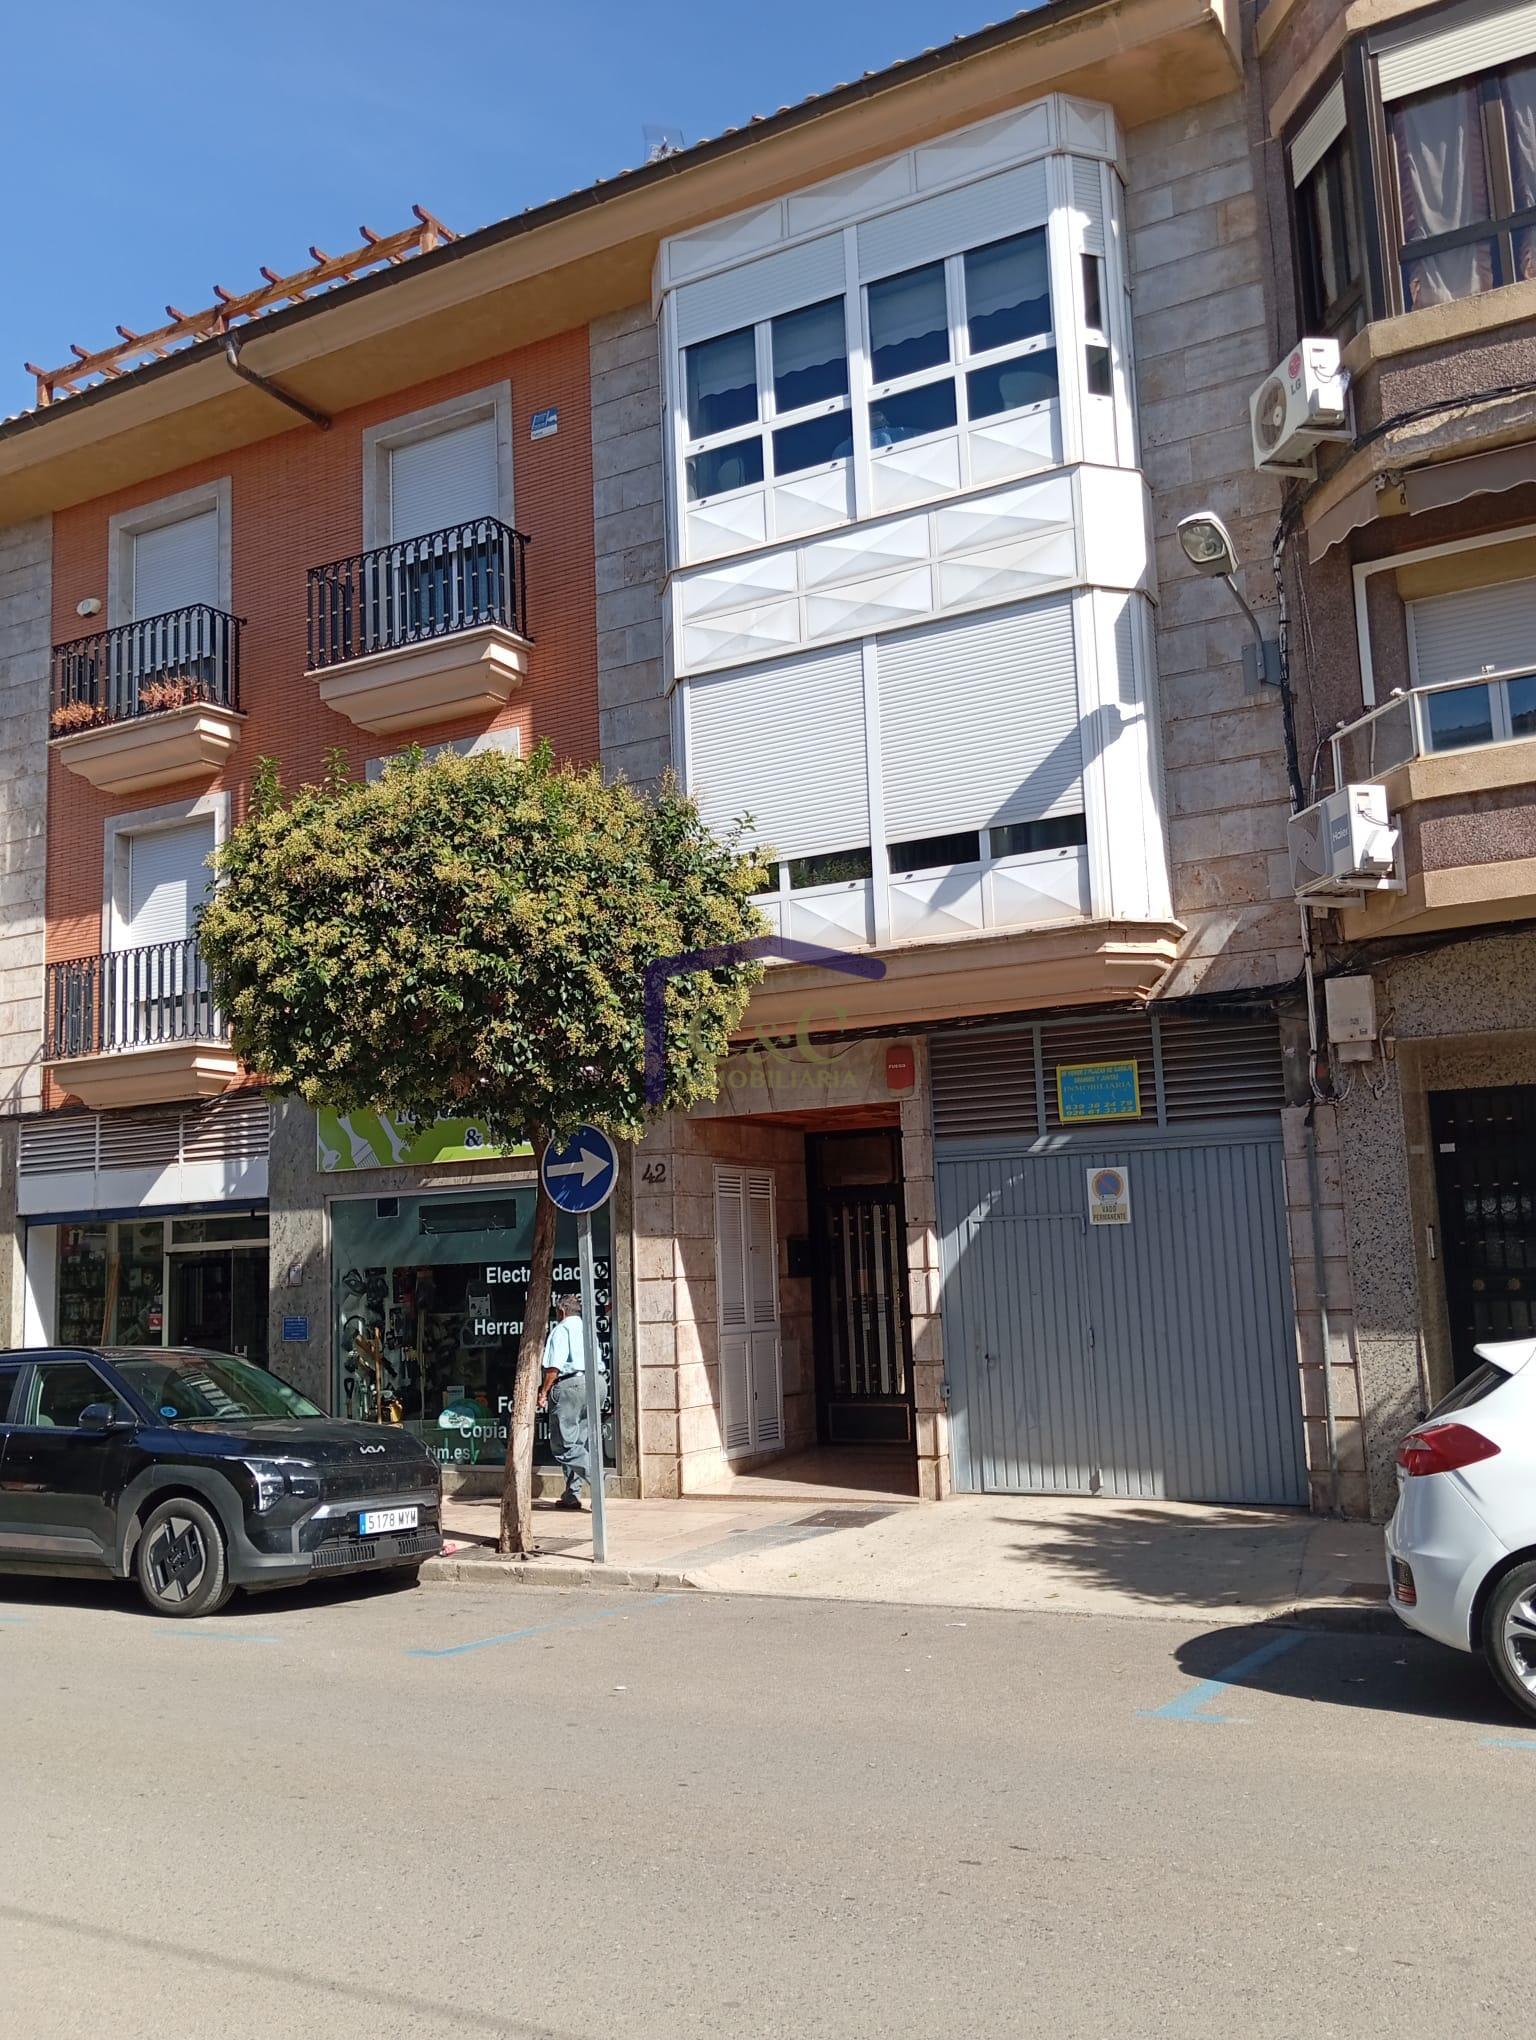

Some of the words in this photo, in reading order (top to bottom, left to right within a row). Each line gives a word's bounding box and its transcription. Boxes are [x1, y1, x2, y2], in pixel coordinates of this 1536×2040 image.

[1290, 378, 1302, 396] LG
[642, 1163, 666, 1184] 42
[459, 1422, 507, 1443] Copia
[368, 1512, 395, 1530] 5178
